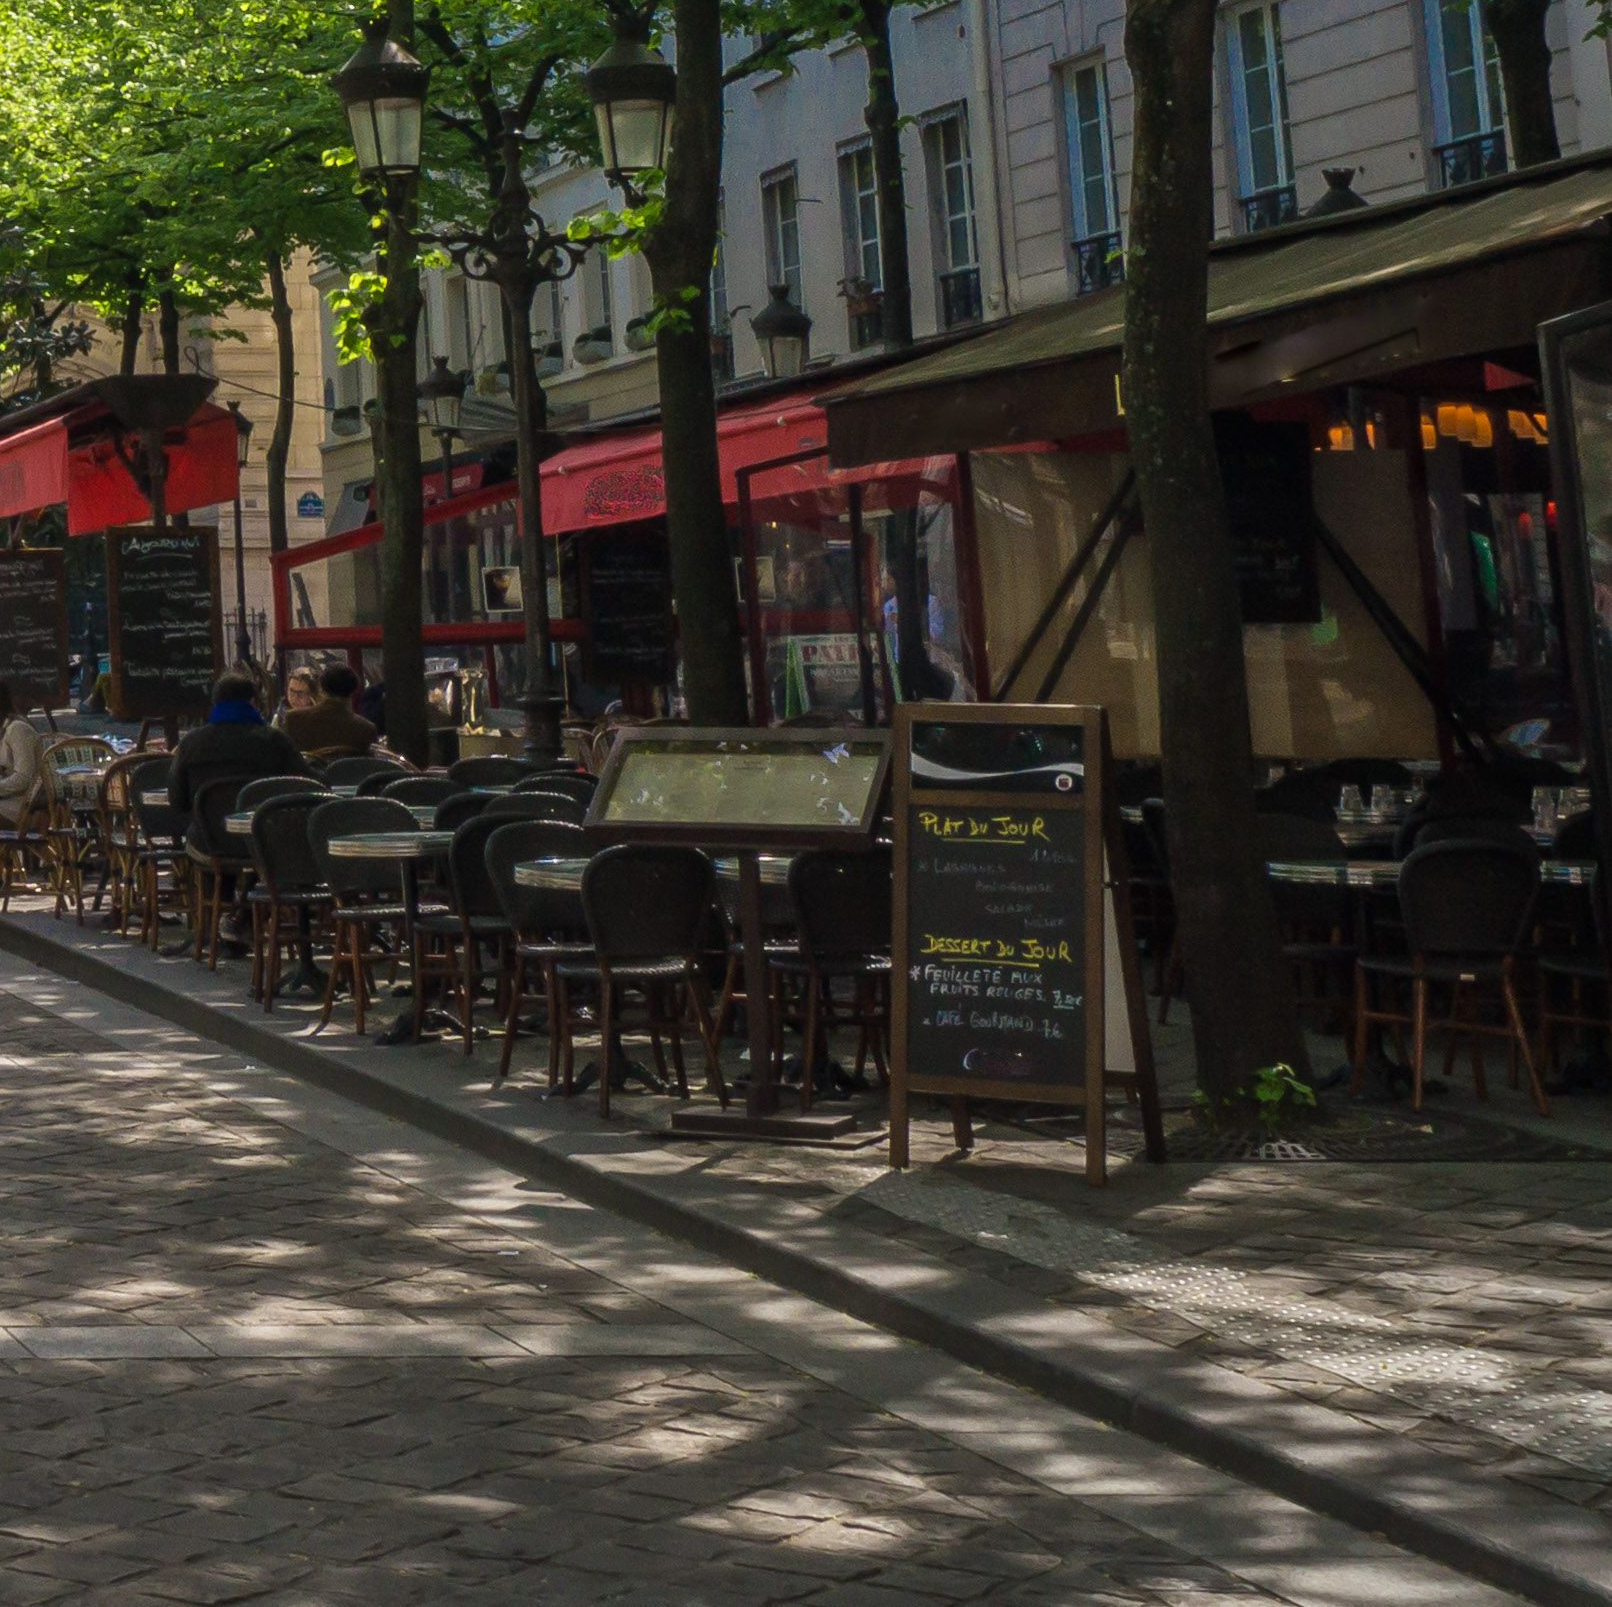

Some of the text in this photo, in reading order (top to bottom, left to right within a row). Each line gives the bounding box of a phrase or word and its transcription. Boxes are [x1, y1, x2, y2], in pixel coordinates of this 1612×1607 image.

[919, 811, 1051, 842] PLAT DU JOUR
[921, 934, 1072, 963] DESSERT DU JOUR
[930, 982, 979, 997] FRUITS
